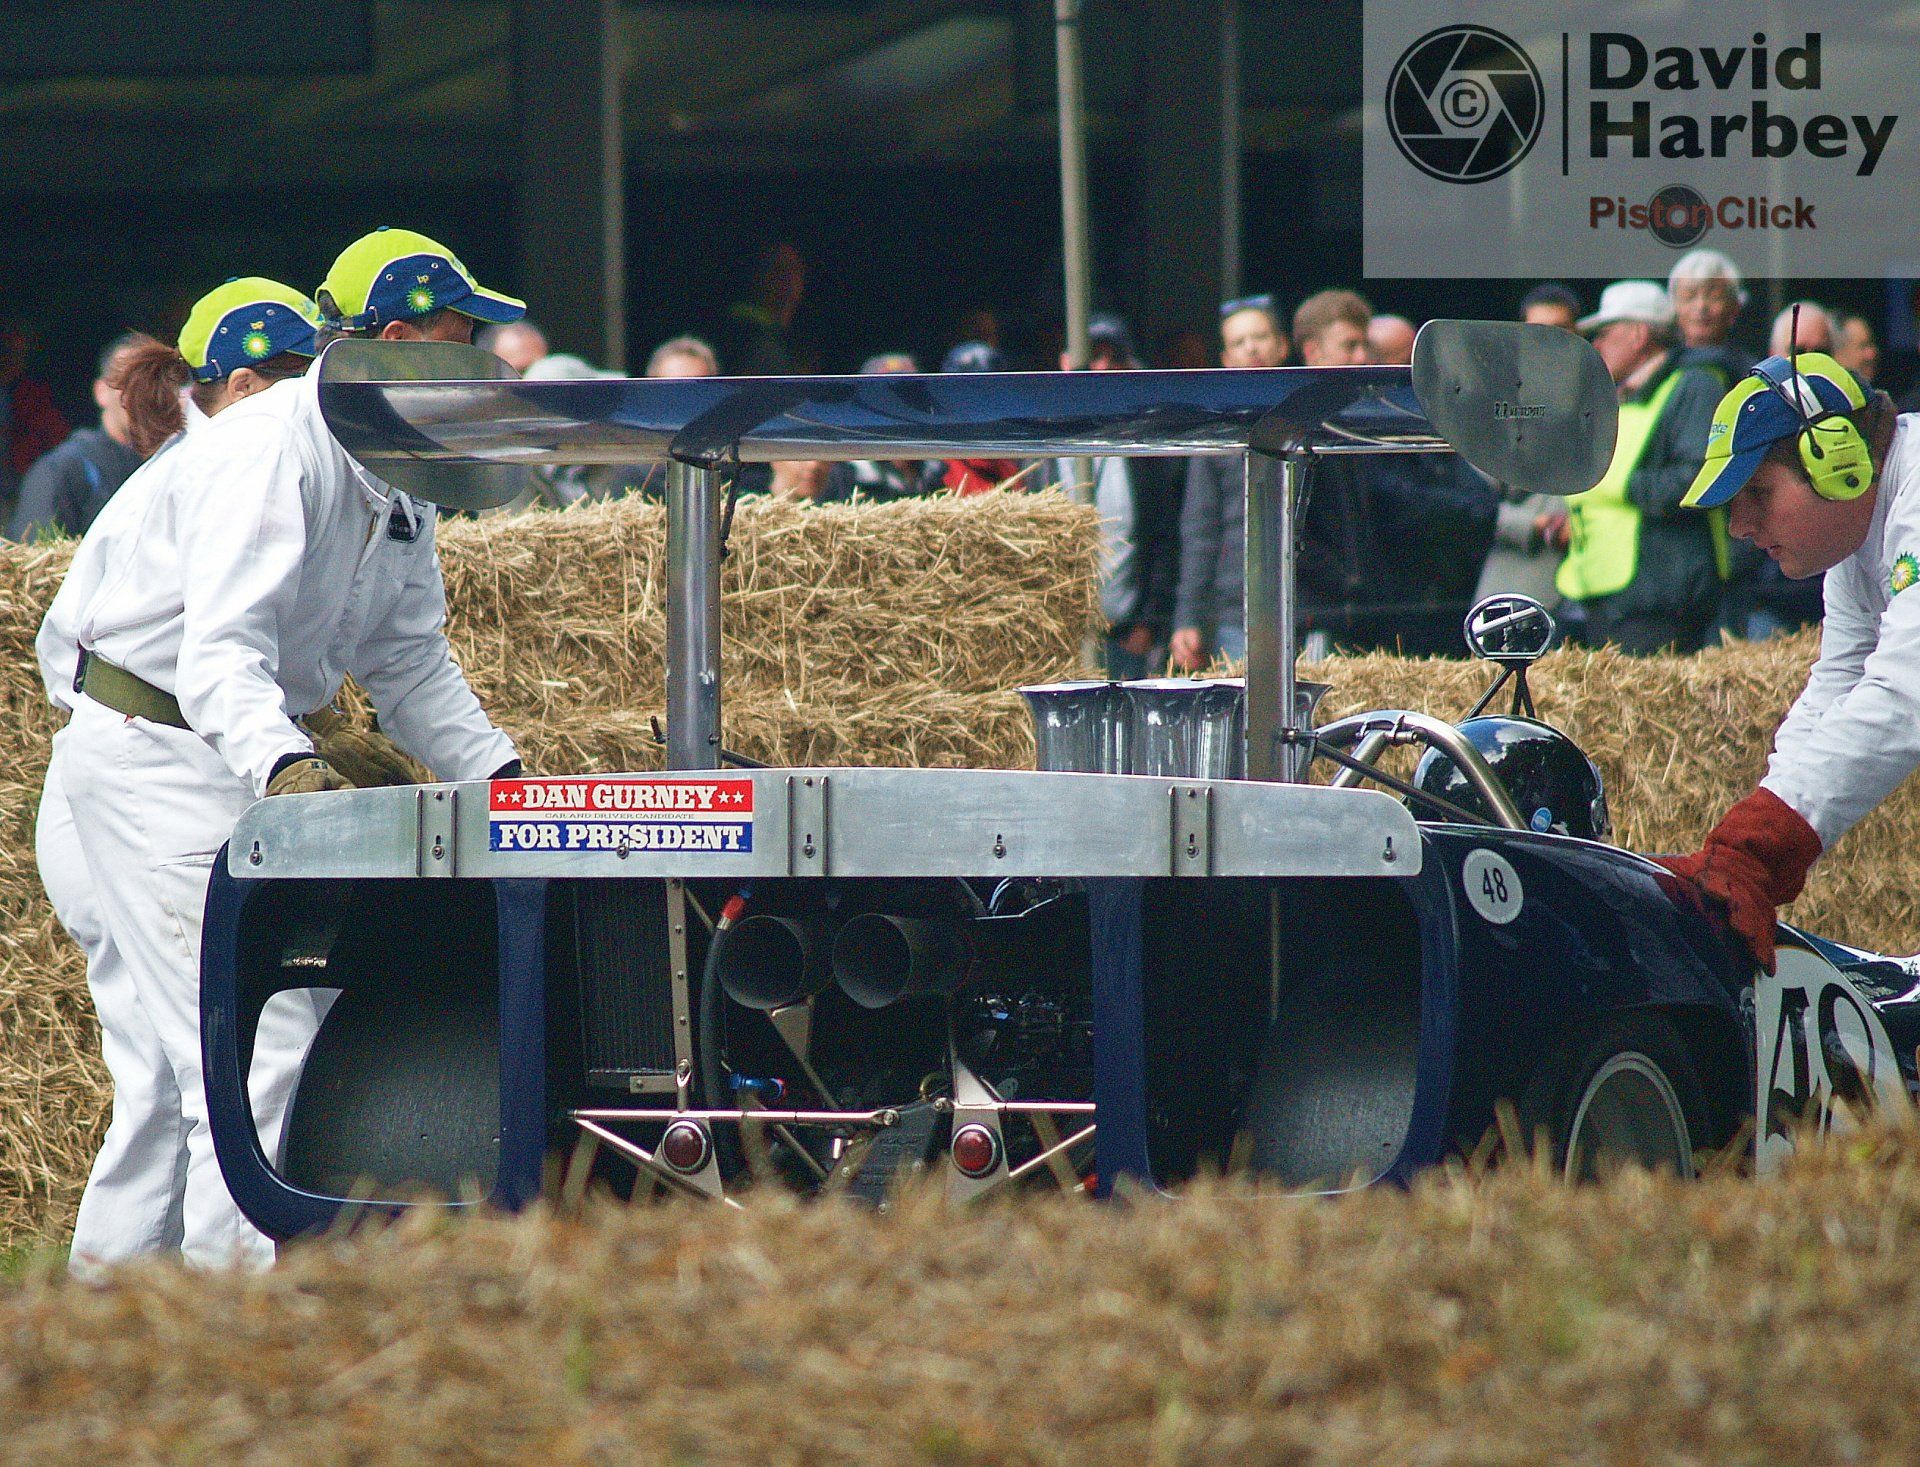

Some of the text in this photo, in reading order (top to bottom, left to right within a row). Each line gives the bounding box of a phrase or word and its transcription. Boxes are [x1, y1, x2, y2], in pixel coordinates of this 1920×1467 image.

[523, 784, 718, 809] DAN GURNEY
[635, 812, 695, 820] CANDIDATE
[499, 824, 743, 850] FOR PRESIDENT
[1483, 867, 1508, 903] 48
